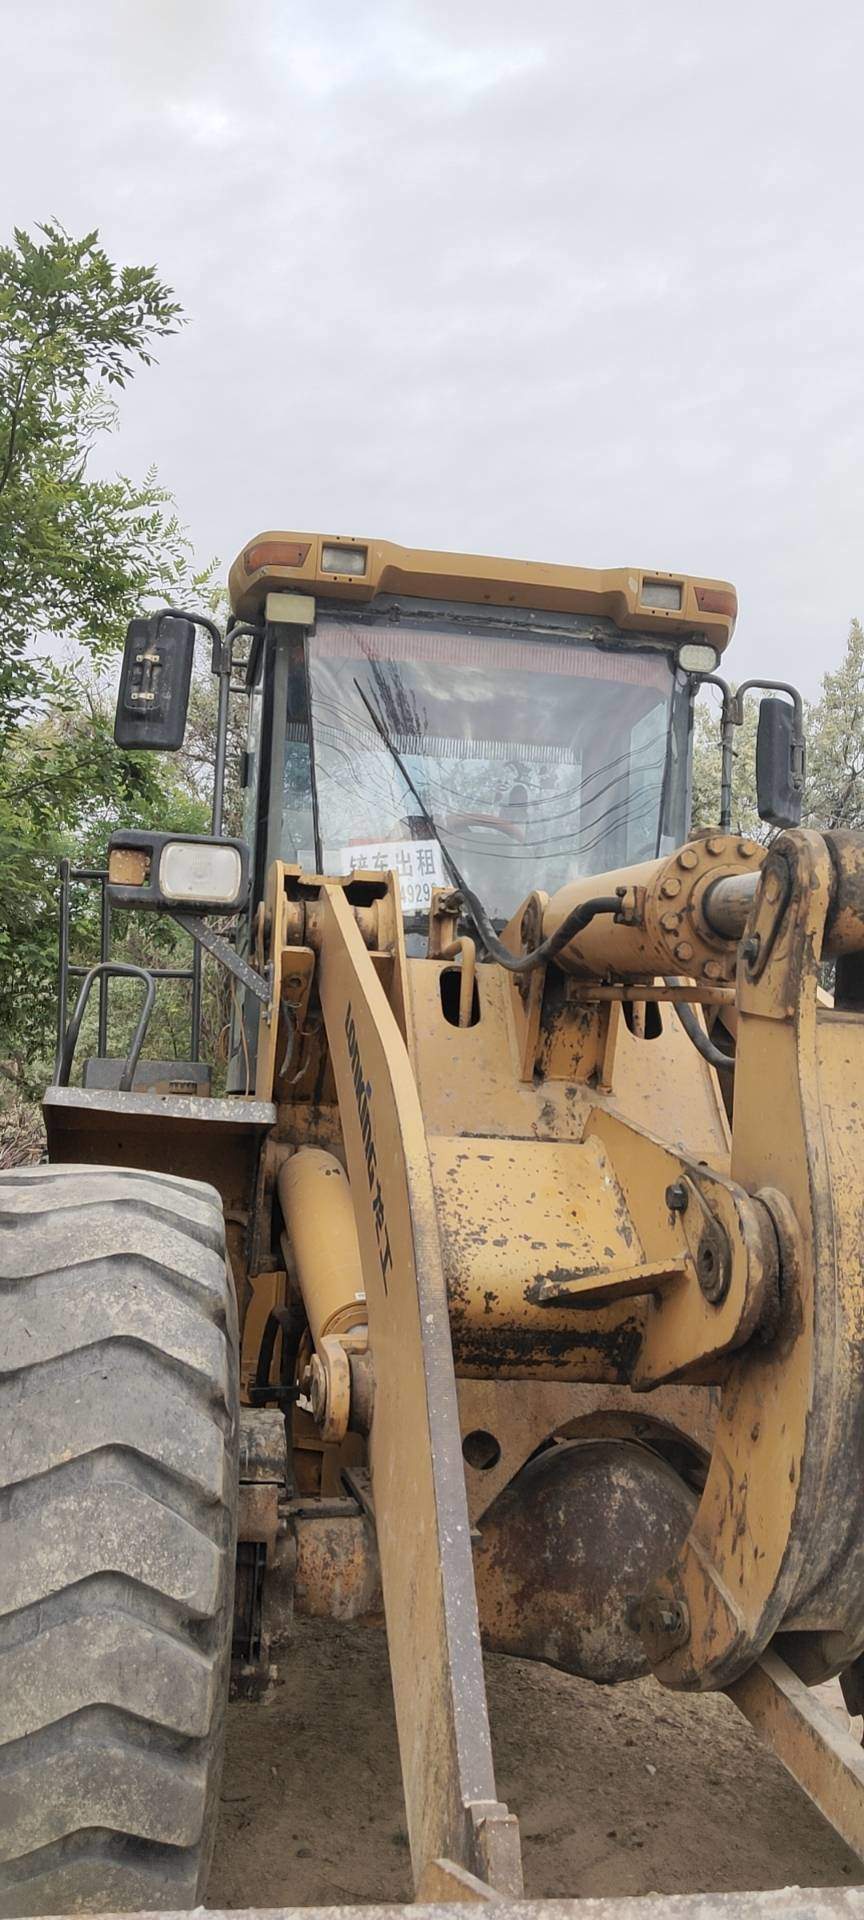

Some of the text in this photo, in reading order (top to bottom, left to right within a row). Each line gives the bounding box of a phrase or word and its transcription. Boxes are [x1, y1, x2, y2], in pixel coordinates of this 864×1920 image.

[350, 848, 436, 877] 铲车出租
[400, 882, 436, 903] 4929
